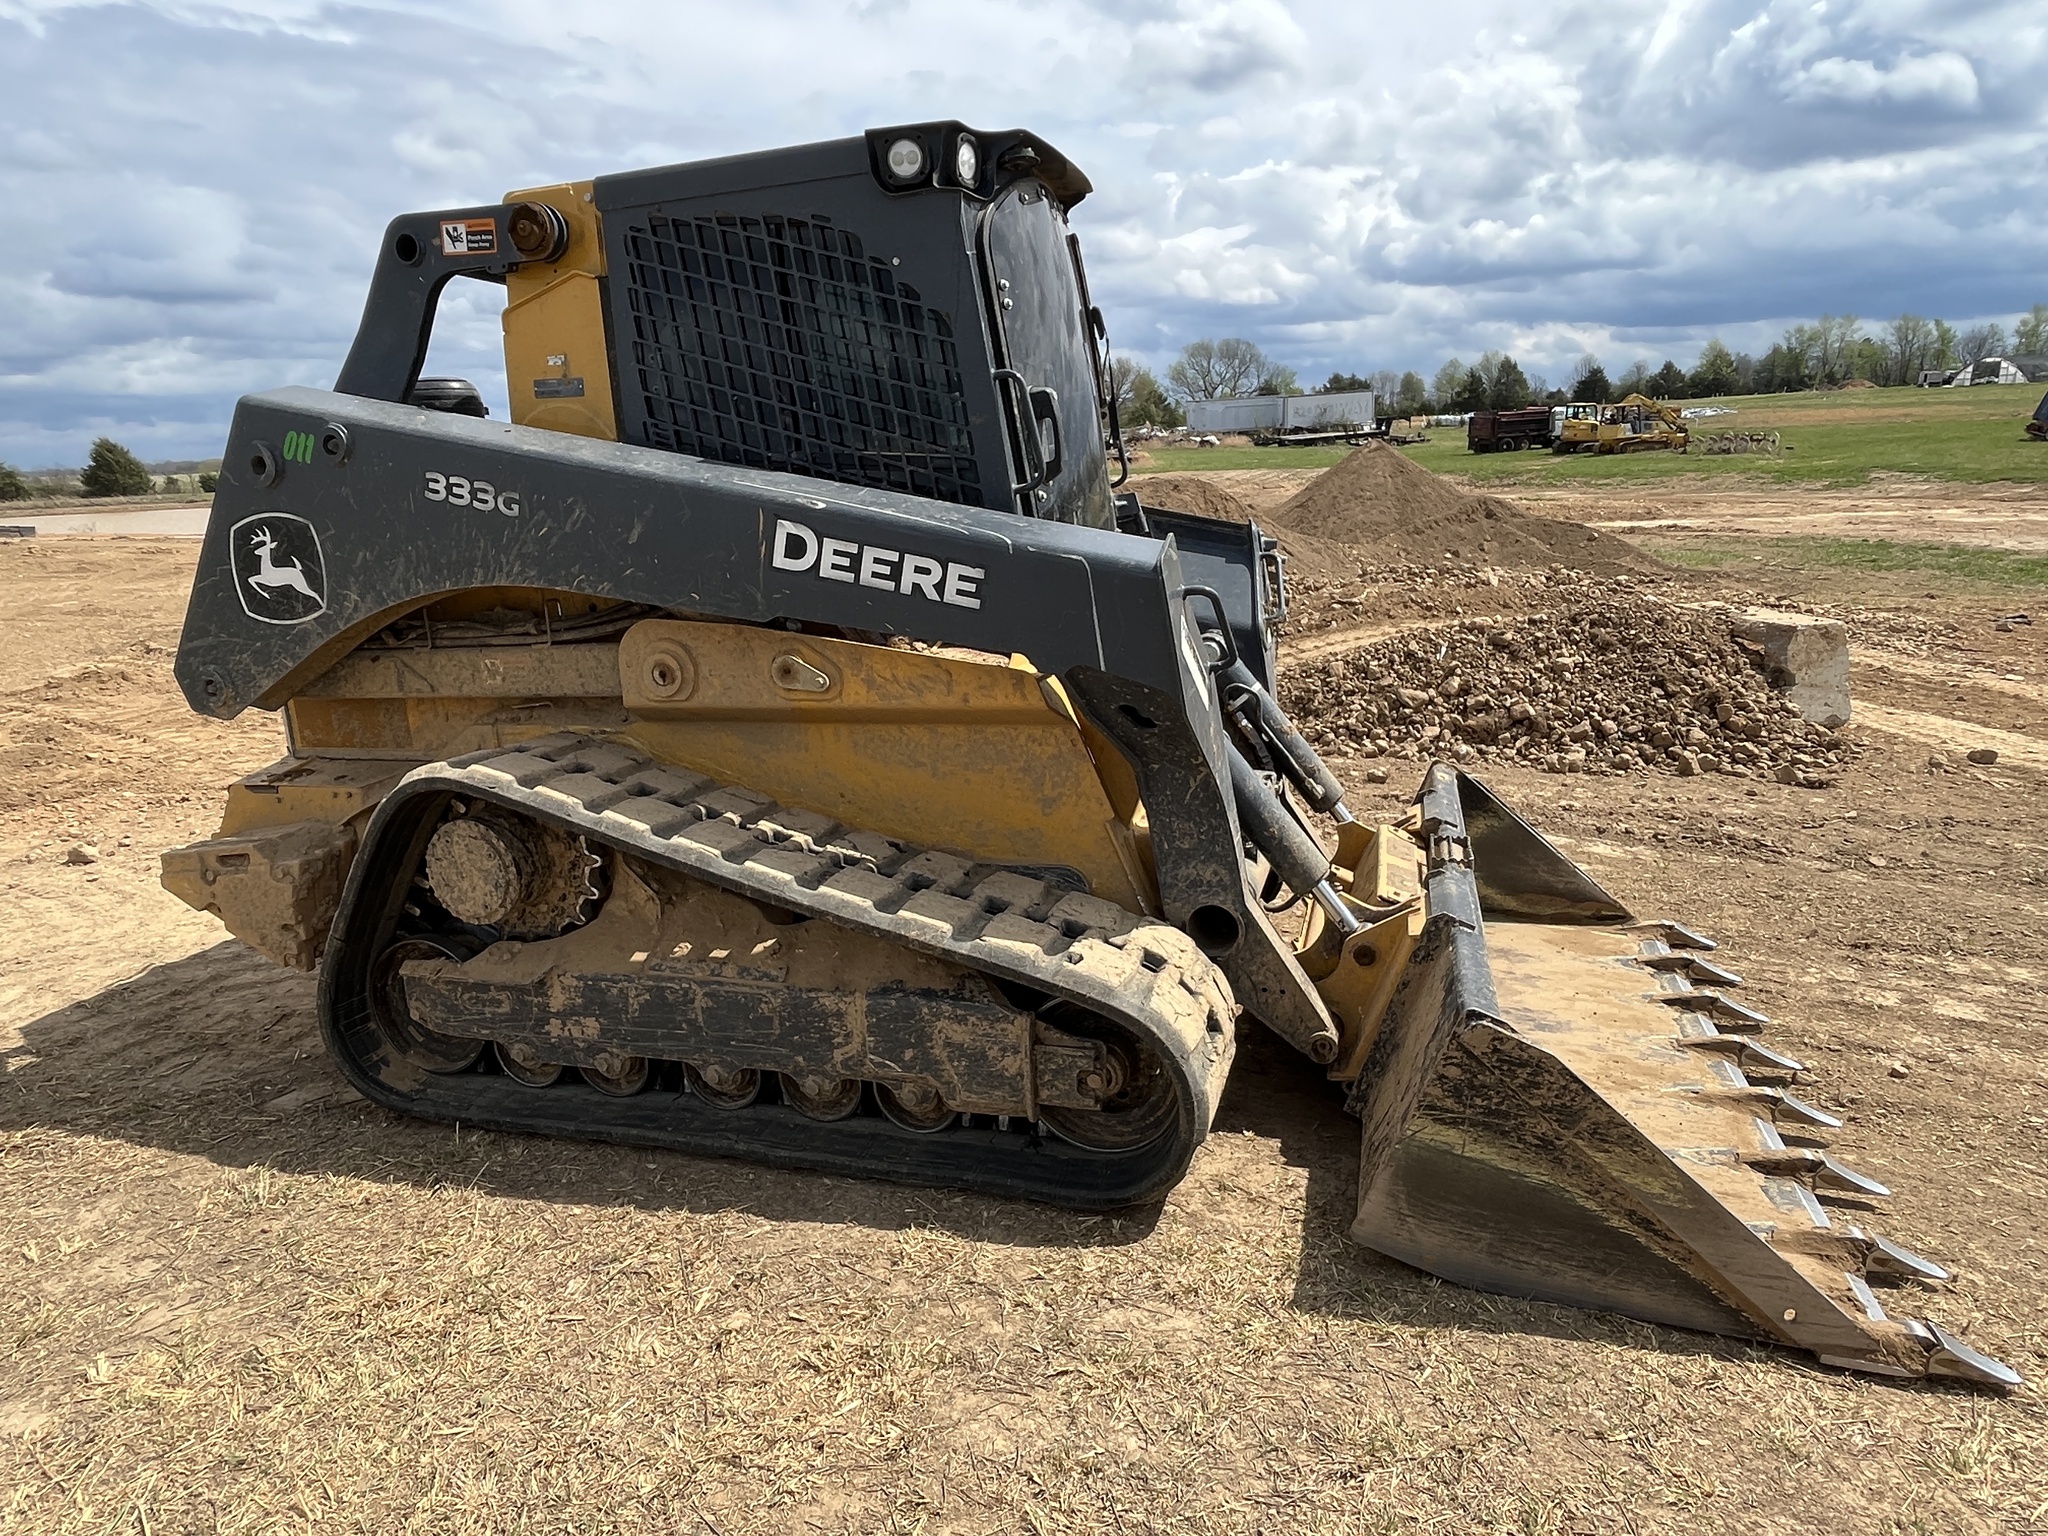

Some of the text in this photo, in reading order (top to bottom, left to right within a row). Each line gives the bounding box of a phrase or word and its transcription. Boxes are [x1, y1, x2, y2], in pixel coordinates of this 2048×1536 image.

[283, 430, 315, 465] 011
[424, 471, 520, 517] 333G
[772, 519, 985, 610] DEERE
